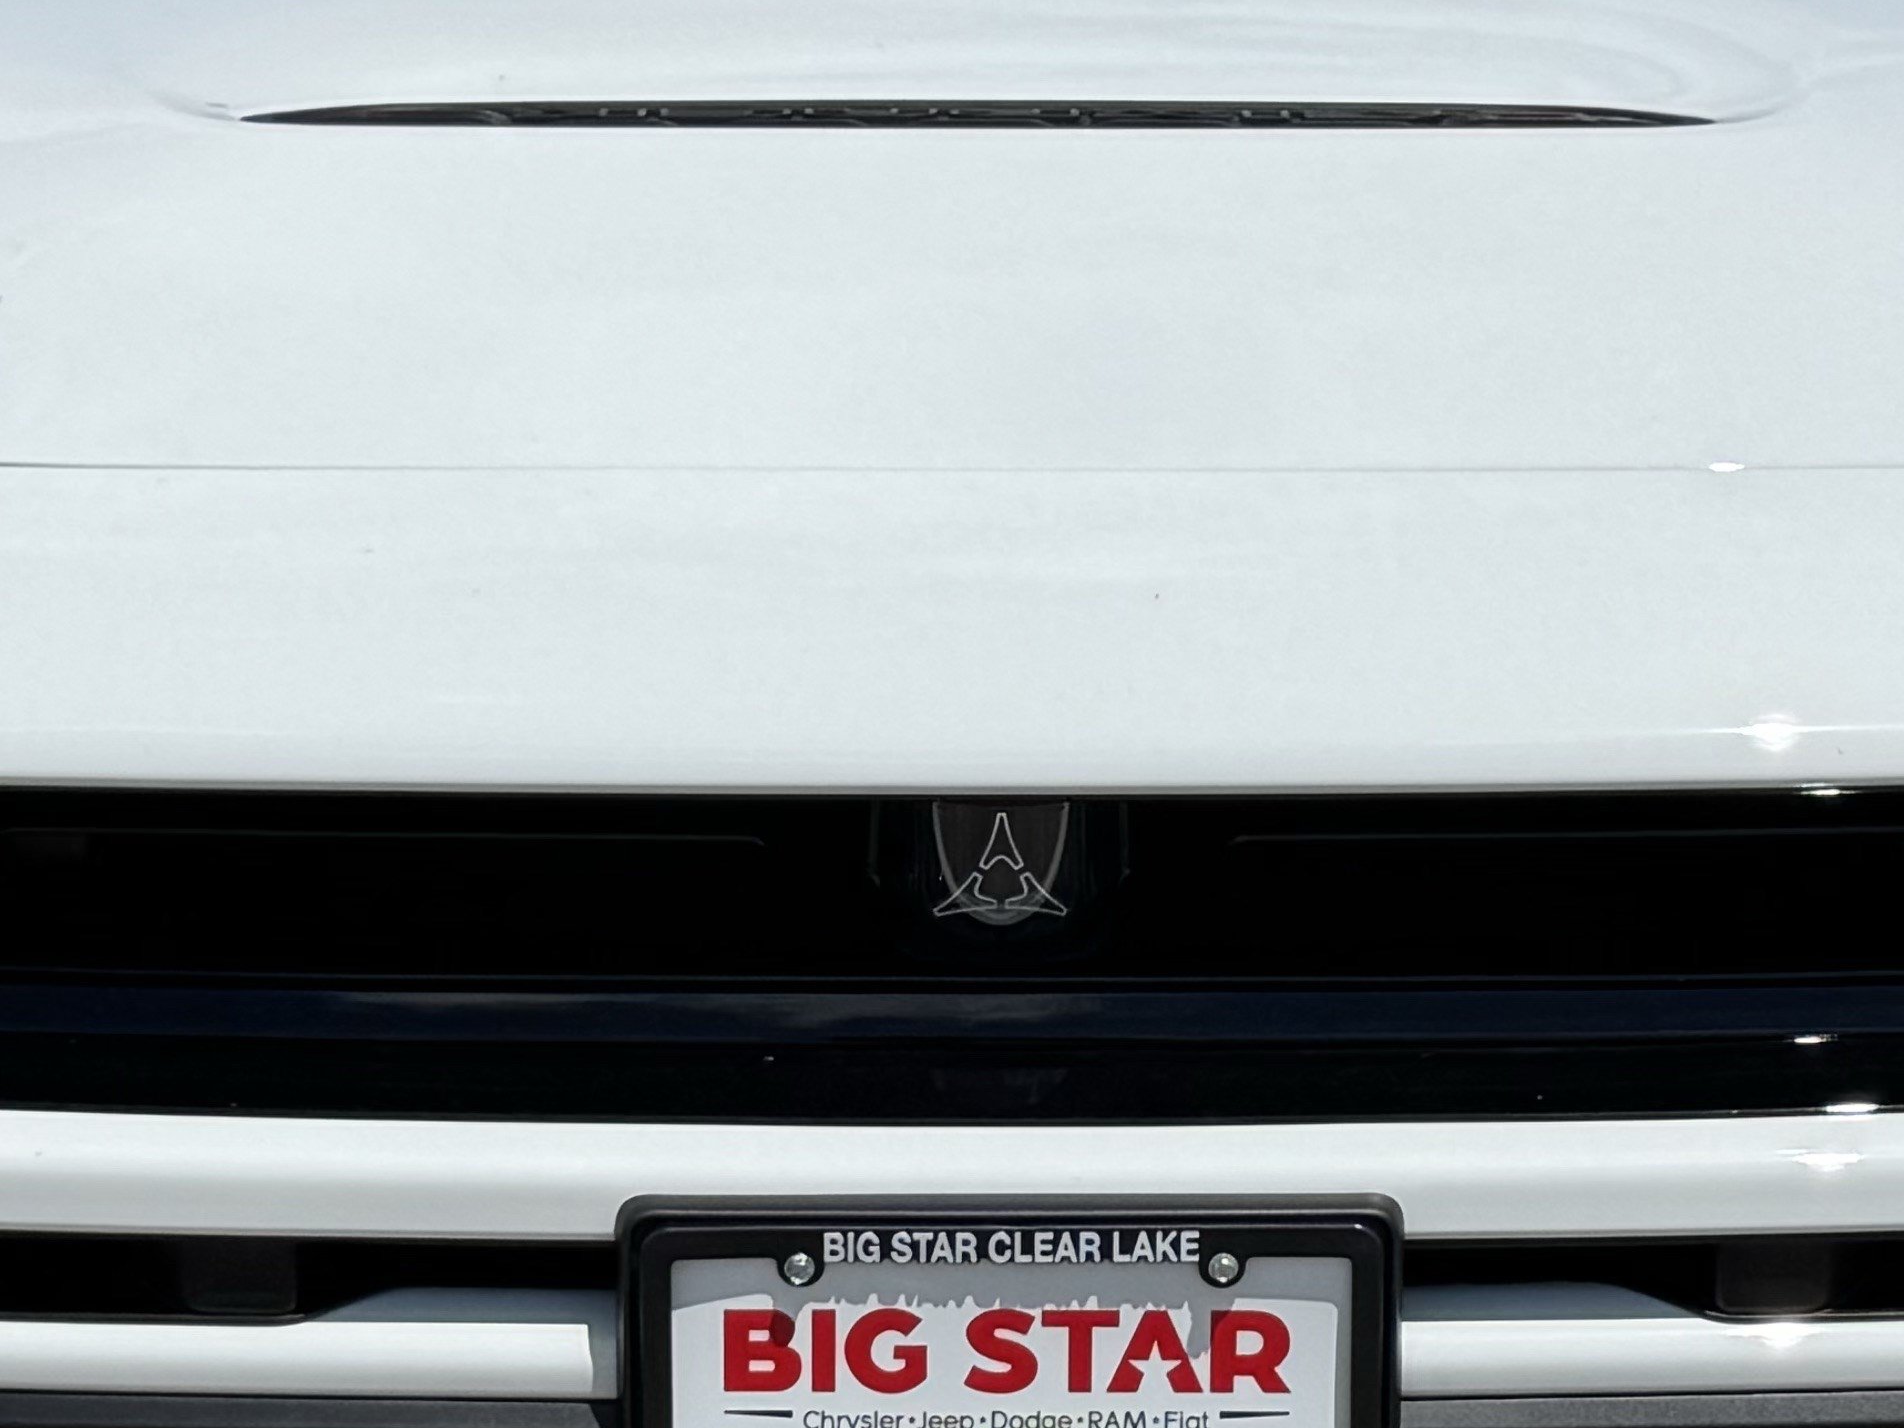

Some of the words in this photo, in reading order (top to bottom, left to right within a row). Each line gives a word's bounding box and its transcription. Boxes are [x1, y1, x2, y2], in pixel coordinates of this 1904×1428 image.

[822, 1231, 881, 1264] BIG
[889, 1231, 978, 1263] STAR
[988, 1231, 1102, 1263] CLEAR
[1112, 1231, 1200, 1263] LAKE
[723, 1308, 928, 1394] BIG
[964, 1308, 1291, 1395] STAR
